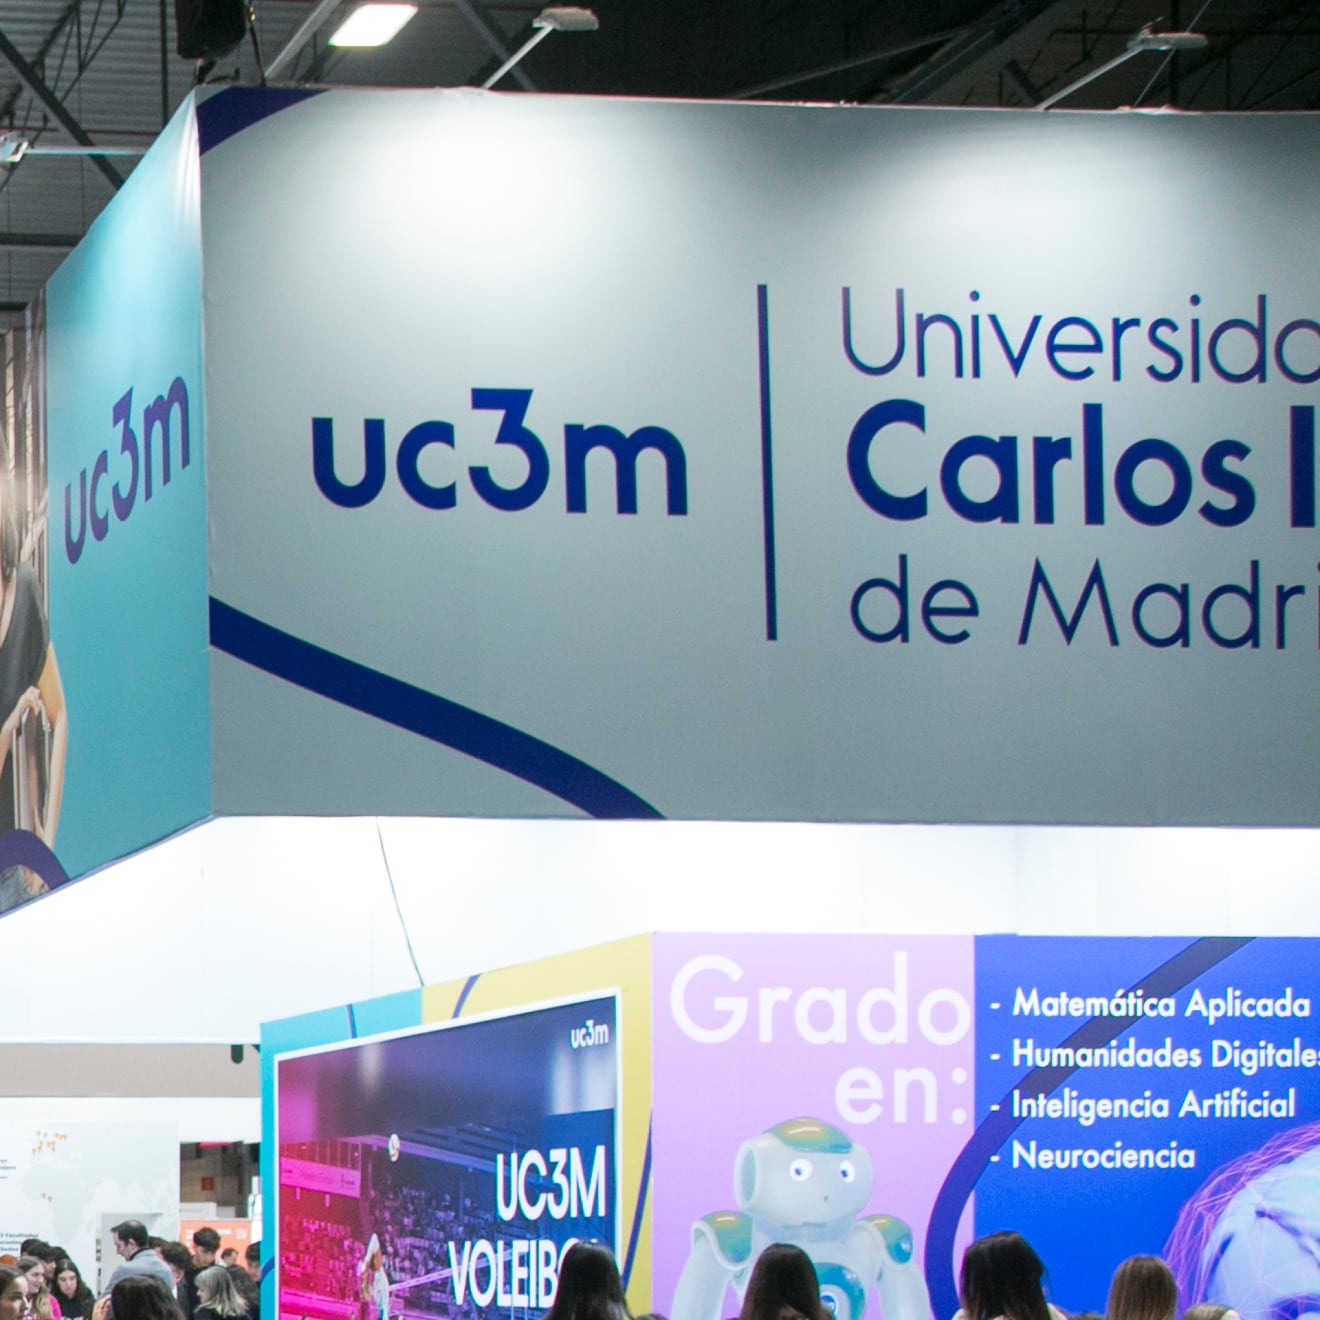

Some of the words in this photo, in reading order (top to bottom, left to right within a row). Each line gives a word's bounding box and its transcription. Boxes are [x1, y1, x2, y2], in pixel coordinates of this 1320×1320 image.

[63, 375, 190, 565] uc3m
[311, 388, 688, 517] uc3m
[847, 398, 1257, 529] Carlos
[851, 554, 980, 646] de
[1018, 557, 1320, 650] Madr
[669, 951, 971, 1046] Grado
[1012, 987, 1176, 1019] Matemática
[1184, 987, 1311, 1024] Aplicada
[571, 1020, 609, 1048] uc3m
[1012, 1037, 1202, 1069] Humanidades
[1212, 1037, 1320, 1076] Digitale
[835, 1065, 968, 1125] en:
[1012, 1089, 1169, 1127] Inteligencia
[1178, 1088, 1296, 1118] Artificial
[496, 1145, 606, 1222] UC3M
[1011, 1140, 1196, 1169] Neurociencia
